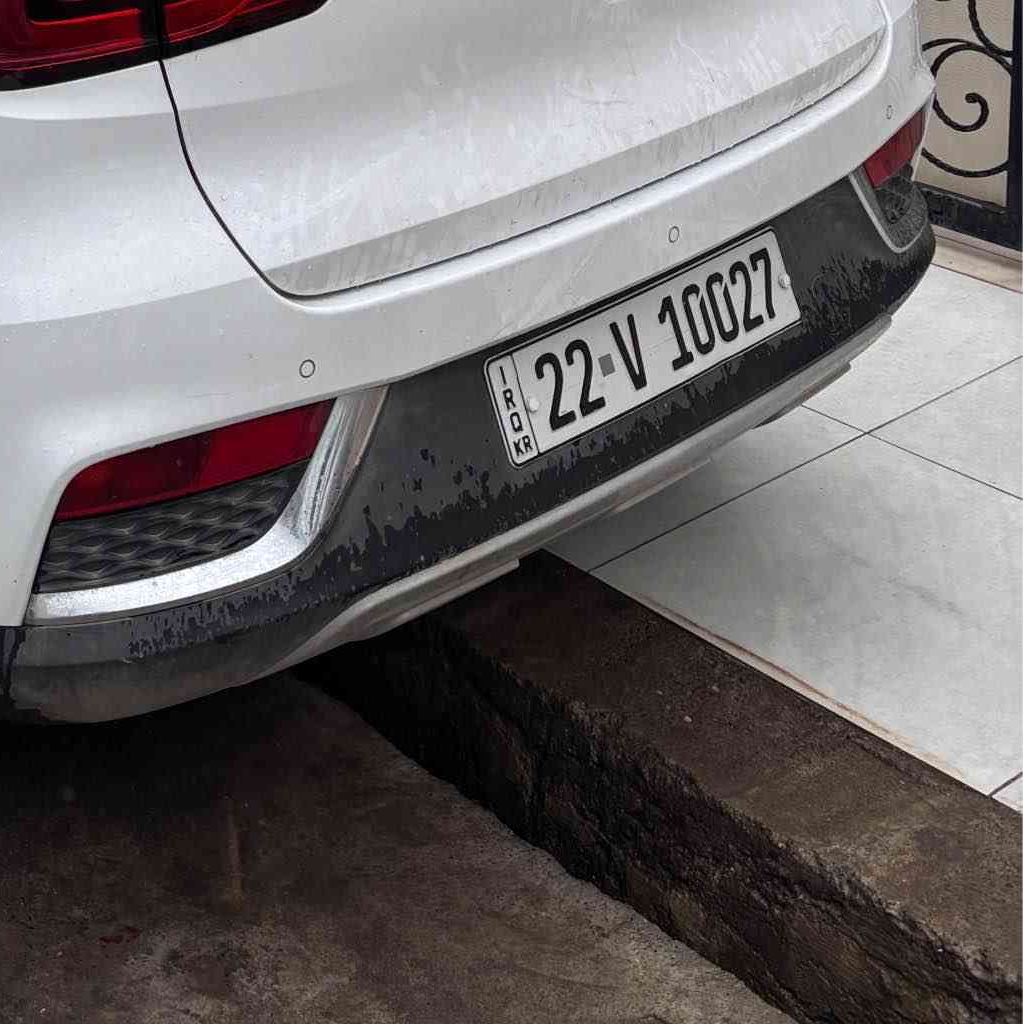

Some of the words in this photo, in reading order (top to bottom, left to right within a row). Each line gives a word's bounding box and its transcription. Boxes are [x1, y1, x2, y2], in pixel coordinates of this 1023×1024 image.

[534, 339, 606, 431] 22
[609, 313, 648, 390] V
[658, 248, 776, 371] 10027
[499, 365, 524, 432] IRQ
[513, 435, 533, 456] KR
